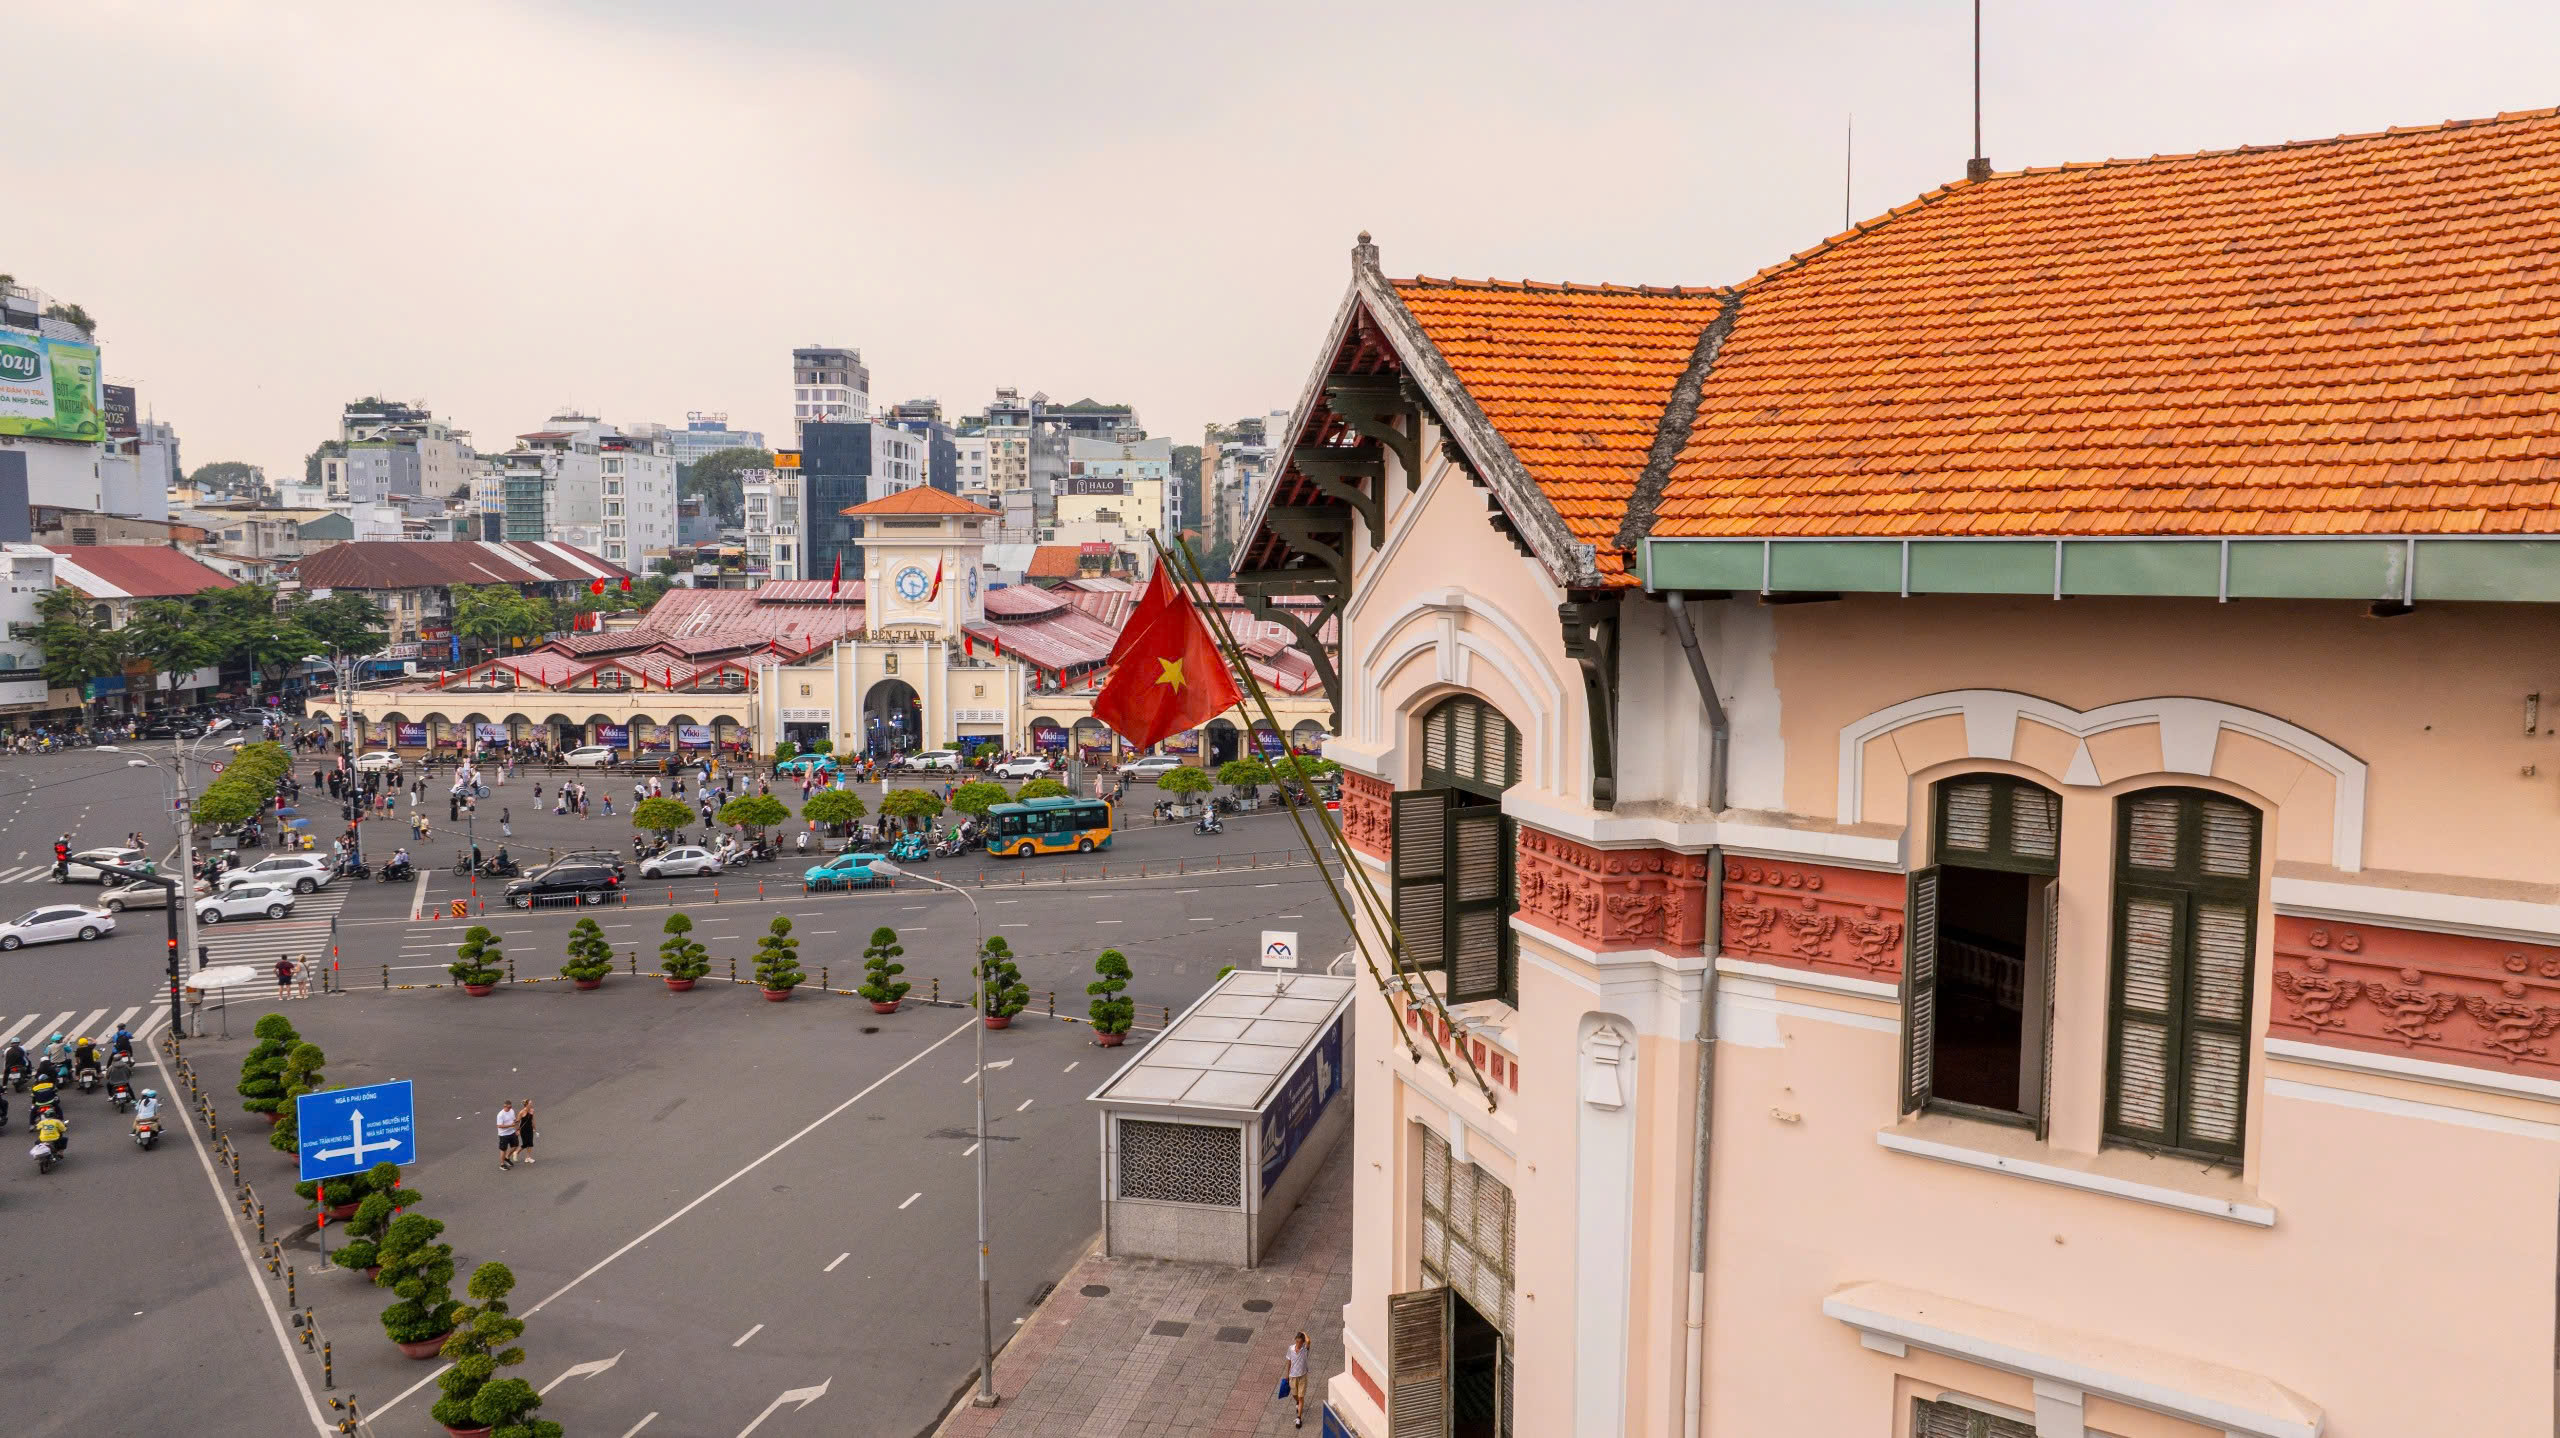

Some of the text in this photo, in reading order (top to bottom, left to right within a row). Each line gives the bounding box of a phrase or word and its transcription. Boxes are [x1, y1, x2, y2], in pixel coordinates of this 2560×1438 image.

[0, 352, 35, 376] ozy
[400, 724, 418, 734] Vikki
[478, 724, 496, 735] Vikki
[599, 725, 618, 737] Vikki
[680, 727, 700, 738] Vikki
[1038, 729, 1057, 740] Vikki
